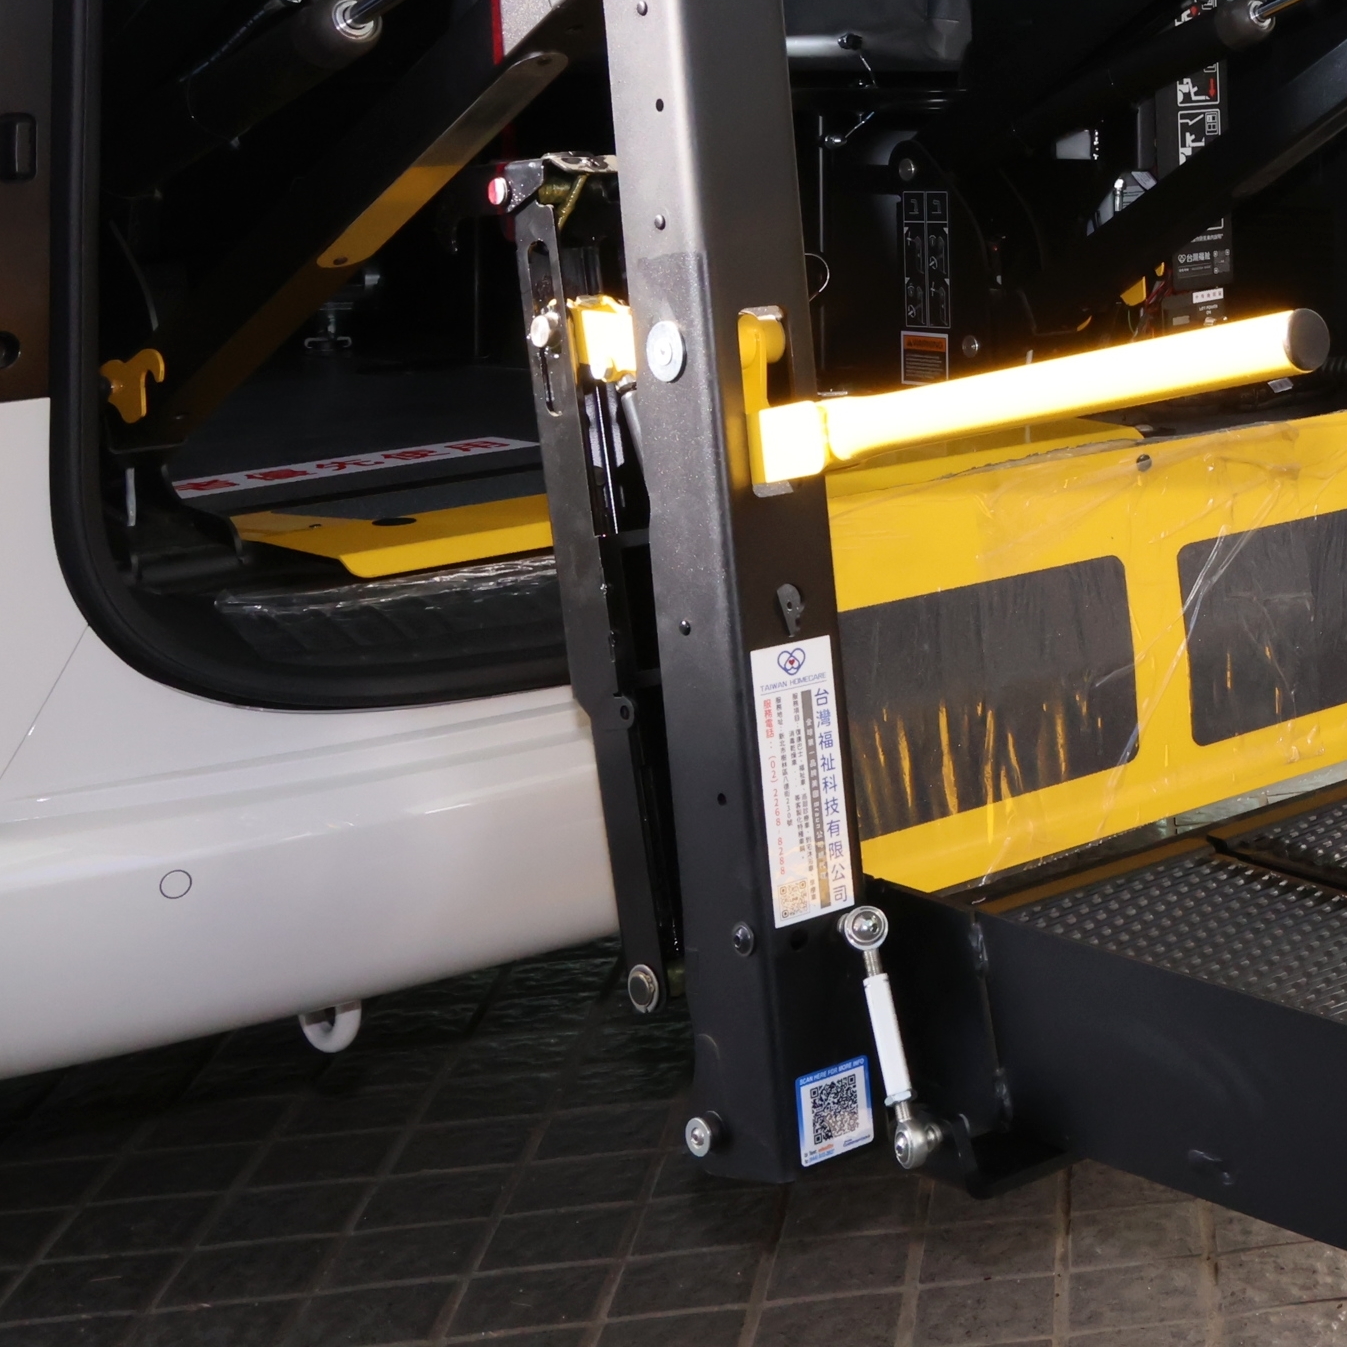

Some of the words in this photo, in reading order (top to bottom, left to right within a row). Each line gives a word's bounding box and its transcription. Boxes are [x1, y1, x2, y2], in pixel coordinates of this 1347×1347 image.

[760, 680, 788, 692] TAIWAN
[789, 672, 827, 686] HOMECARE
[814, 686, 848, 904] 台灣福祉科技有限公司
[799, 1076, 813, 1086] SCAN
[813, 1071, 827, 1080] HERE
[827, 1067, 838, 1075] FOR
